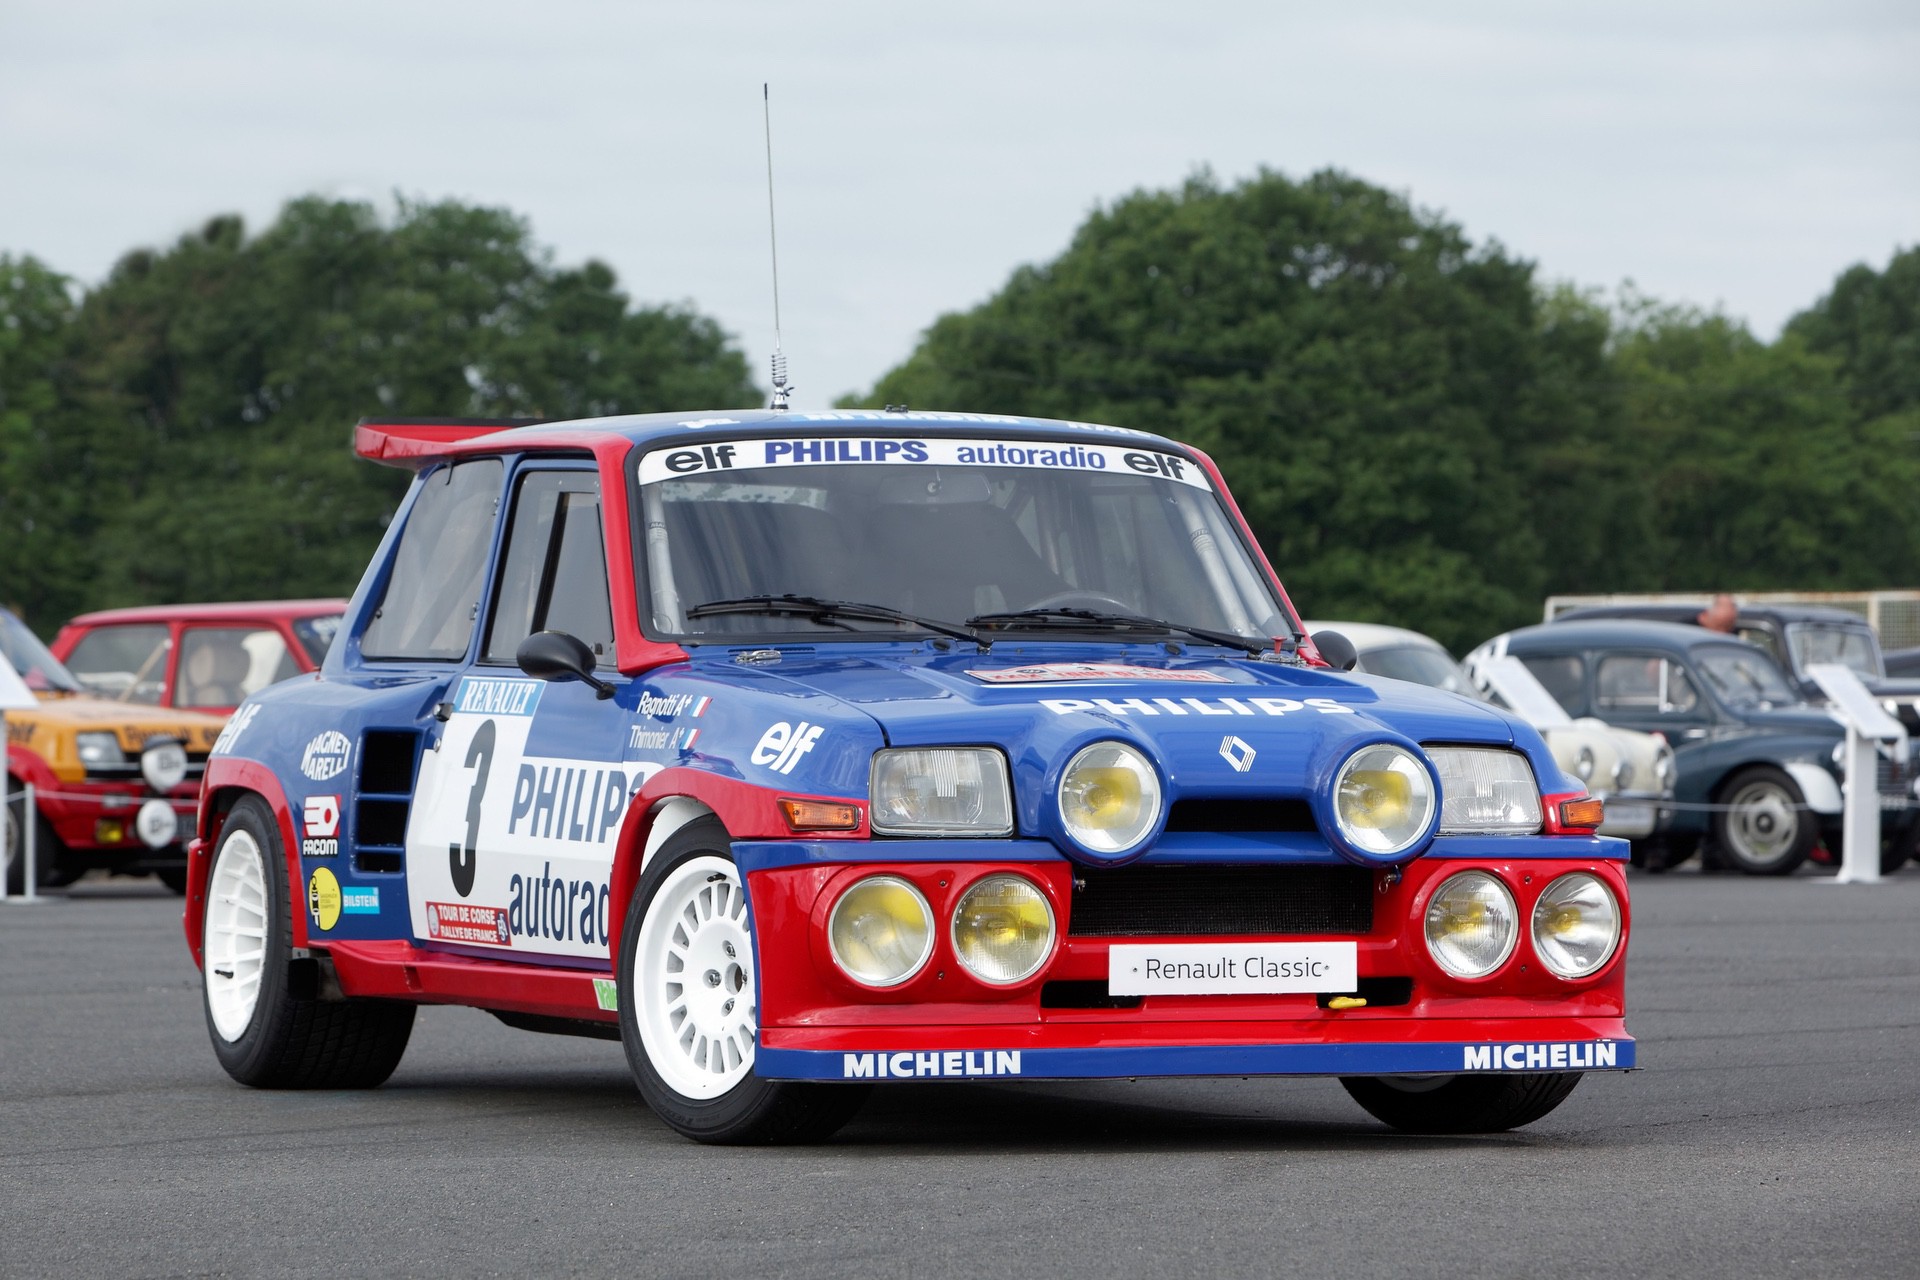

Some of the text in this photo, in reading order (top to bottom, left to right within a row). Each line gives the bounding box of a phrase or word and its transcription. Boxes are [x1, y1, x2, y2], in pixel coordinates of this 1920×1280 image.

[665, 445, 737, 473] elf
[765, 440, 929, 464] PHILIPS
[957, 444, 1106, 469] autoradio
[1123, 452, 1185, 481] elf
[459, 681, 537, 714] RENAULT
[636, 691, 681, 720] Ragnotti
[1038, 698, 1356, 717] PHILIPS
[629, 725, 670, 750] Thimonier
[751, 721, 825, 775] elf
[448, 718, 497, 898] 3
[303, 839, 338, 855] FACOM
[343, 895, 379, 907] BILSTEIN
[438, 904, 459, 922] TOUR
[459, 906, 470, 923] DE
[470, 908, 497, 925] CORSE
[440, 925, 499, 943] RALLYE DE FRANCE
[1146, 956, 1322, 979] Renault Classic
[843, 1050, 1021, 1078] MICHELIN
[1463, 1043, 1617, 1070] MICHELIN
